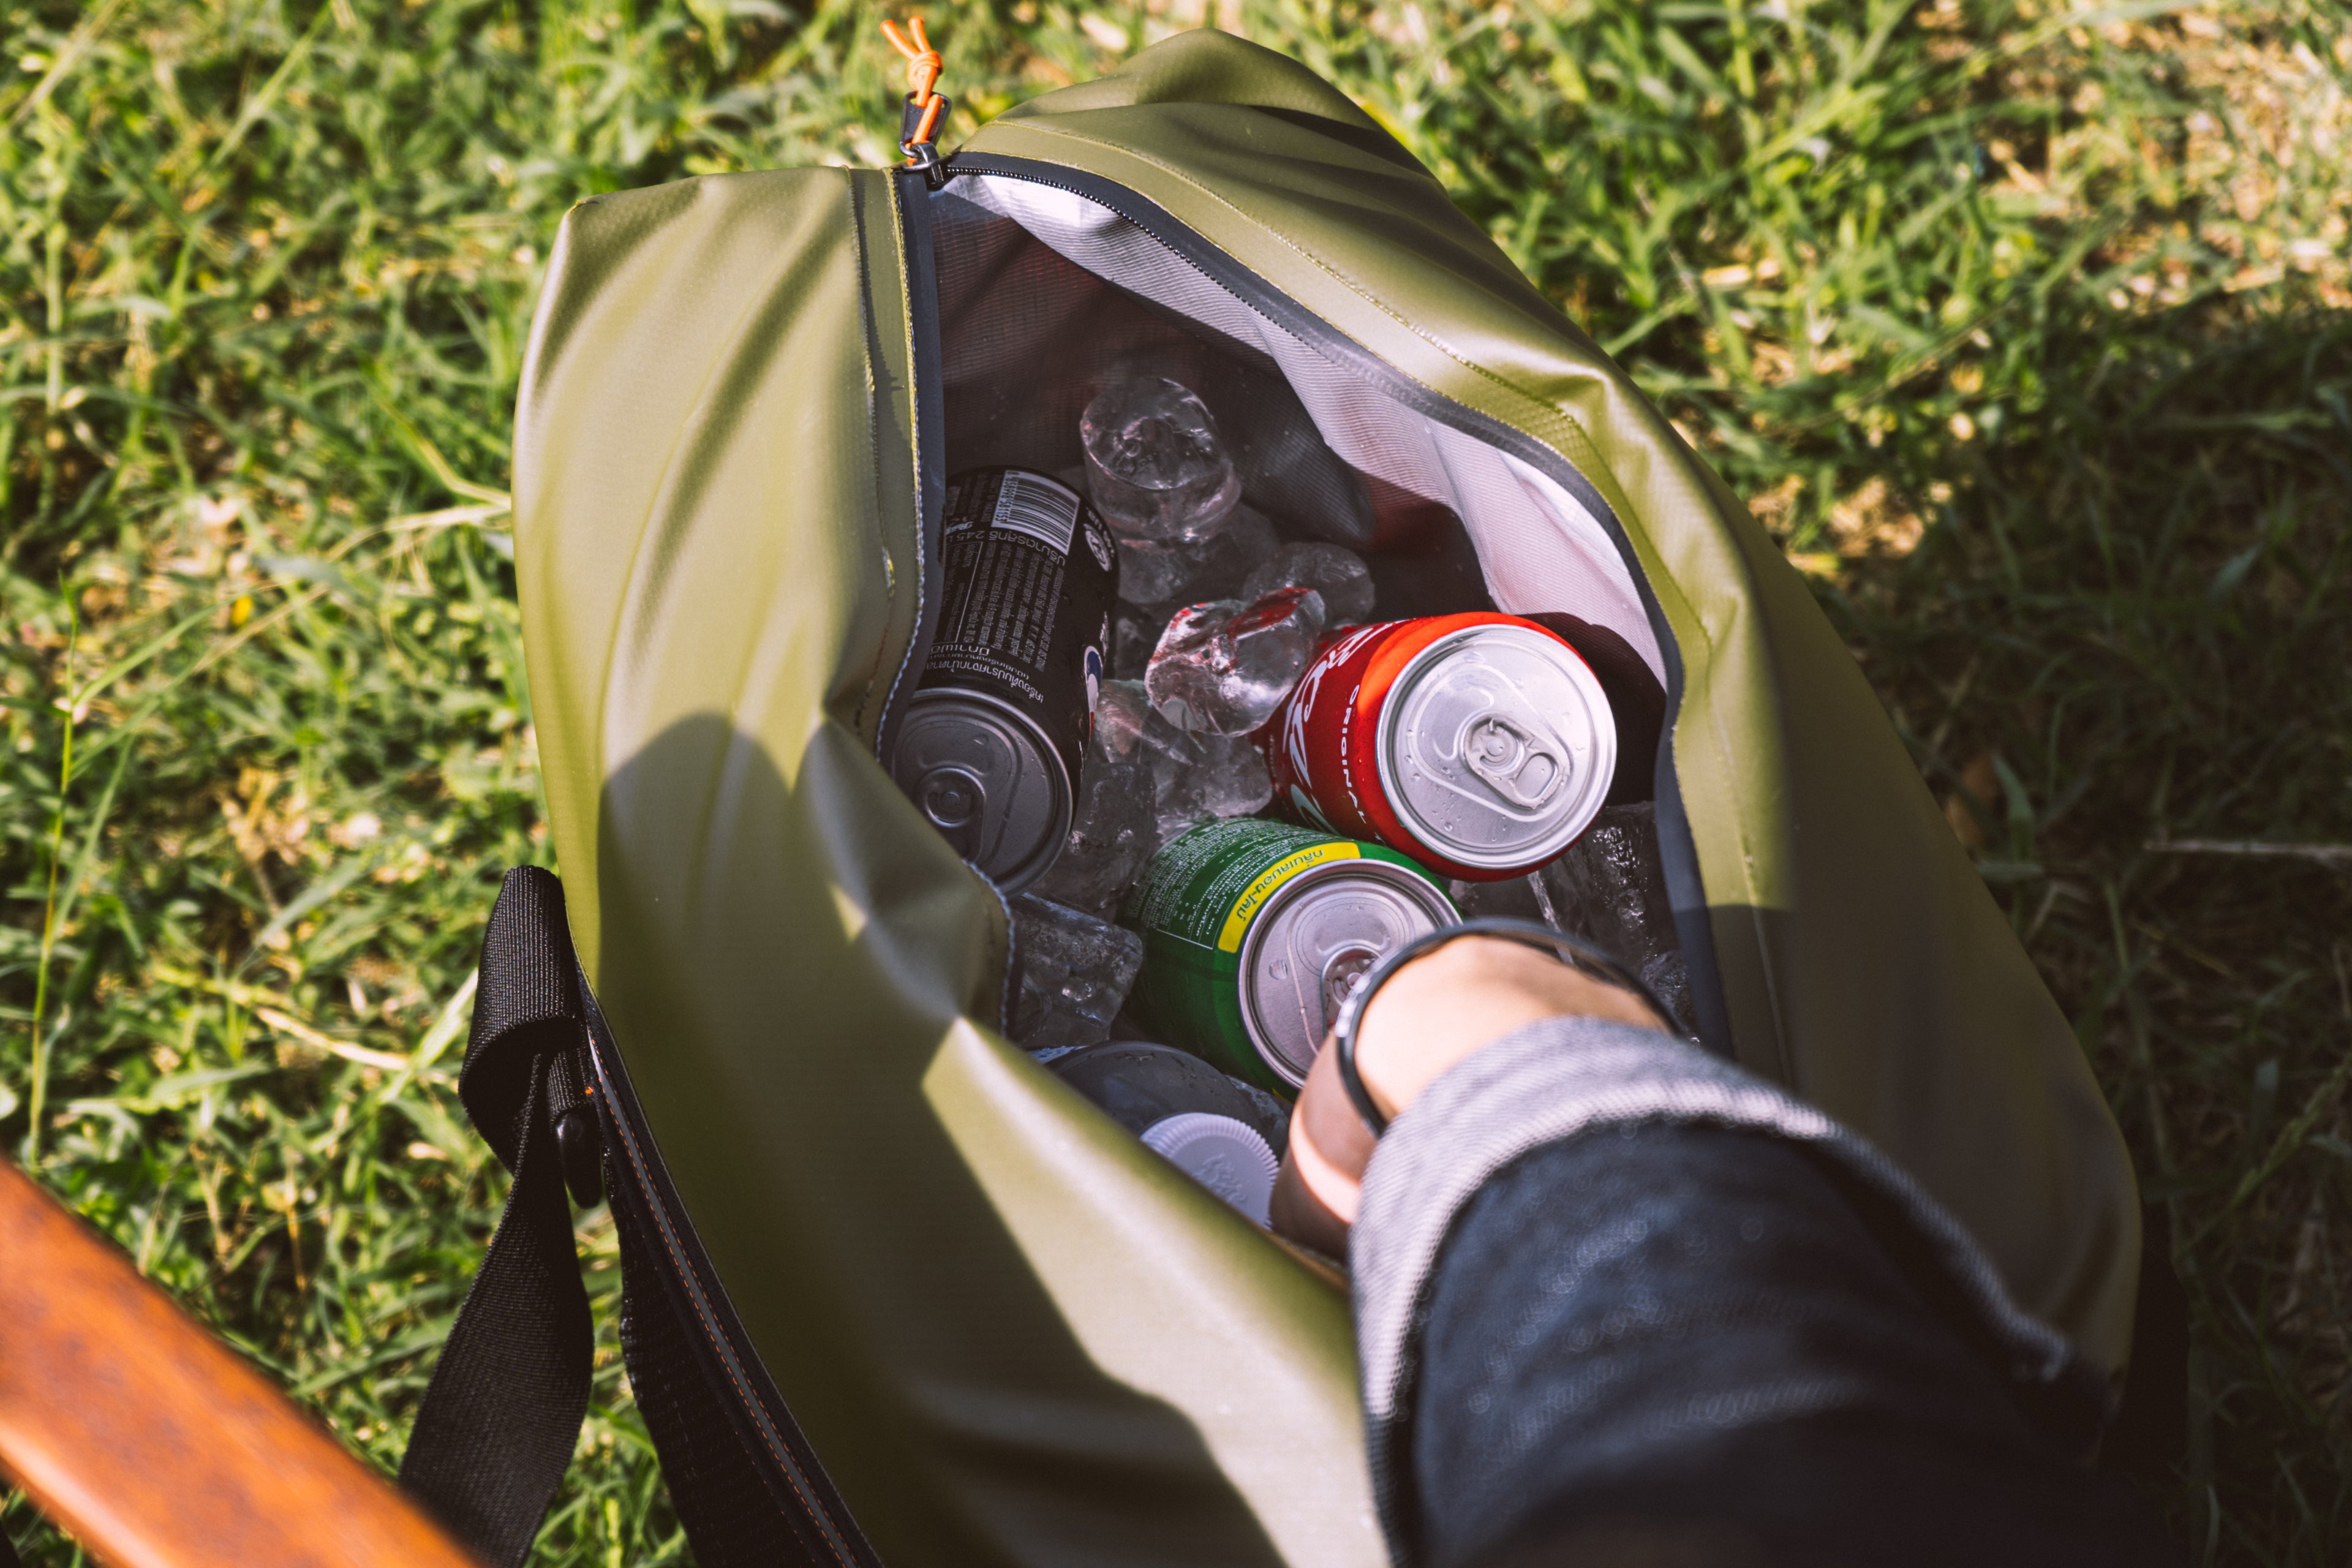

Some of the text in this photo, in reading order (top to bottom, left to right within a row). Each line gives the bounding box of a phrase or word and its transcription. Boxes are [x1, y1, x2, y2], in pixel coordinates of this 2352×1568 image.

[957, 530, 986, 541] 245
[989, 530, 1066, 567] ปริมาตรสุทธิ
[930, 644, 990, 656] มีกาเฟอี
[1341, 684, 1366, 824] ORIGINAL
[1236, 848, 1325, 922] กลิ่นเลมอน-ไลม์
